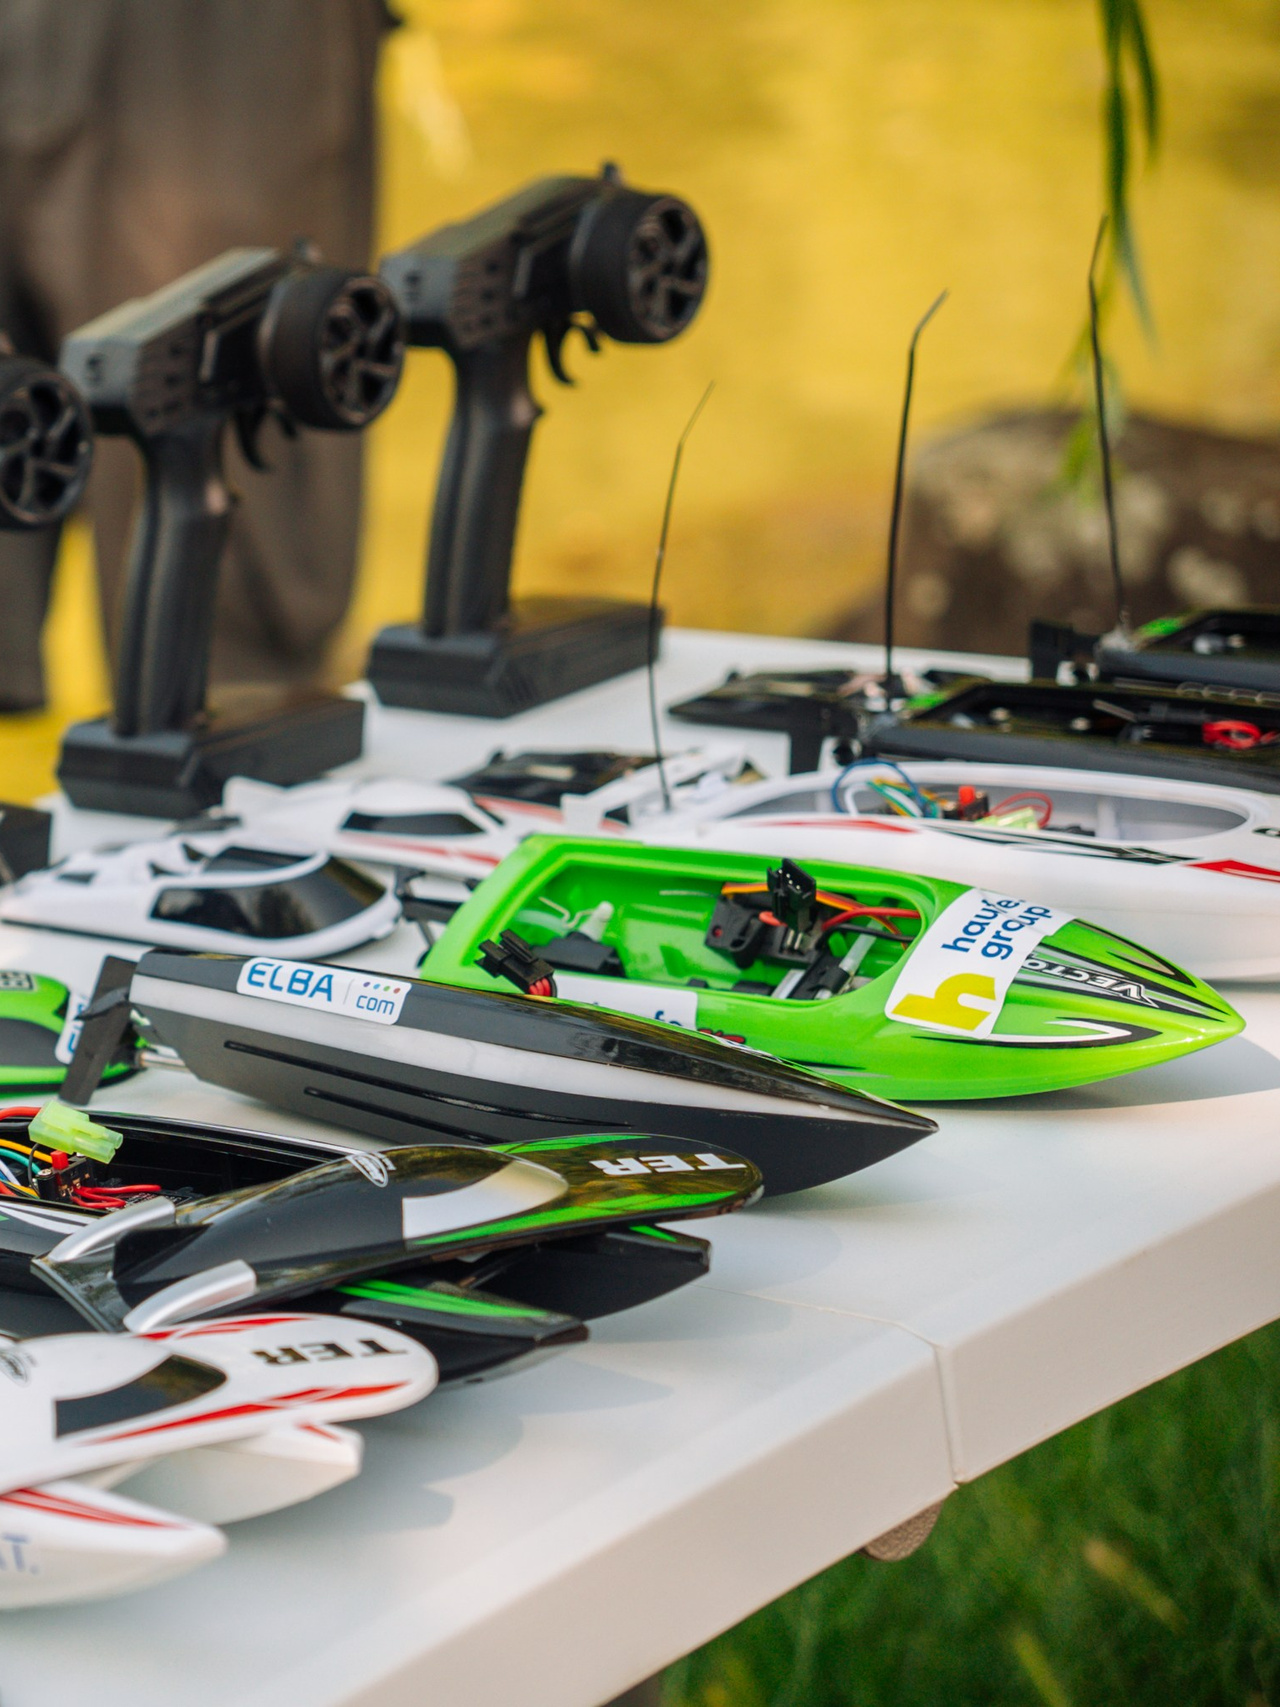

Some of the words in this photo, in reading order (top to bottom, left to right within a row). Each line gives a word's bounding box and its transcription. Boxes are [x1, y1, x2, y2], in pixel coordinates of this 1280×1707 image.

[981, 905, 1053, 960] group
[247, 962, 334, 1002] ELBA
[356, 994, 396, 1016] com
[1022, 957, 1147, 1000] VECTO
[589, 1153, 748, 1176] TER
[251, 1339, 409, 1367] TER
